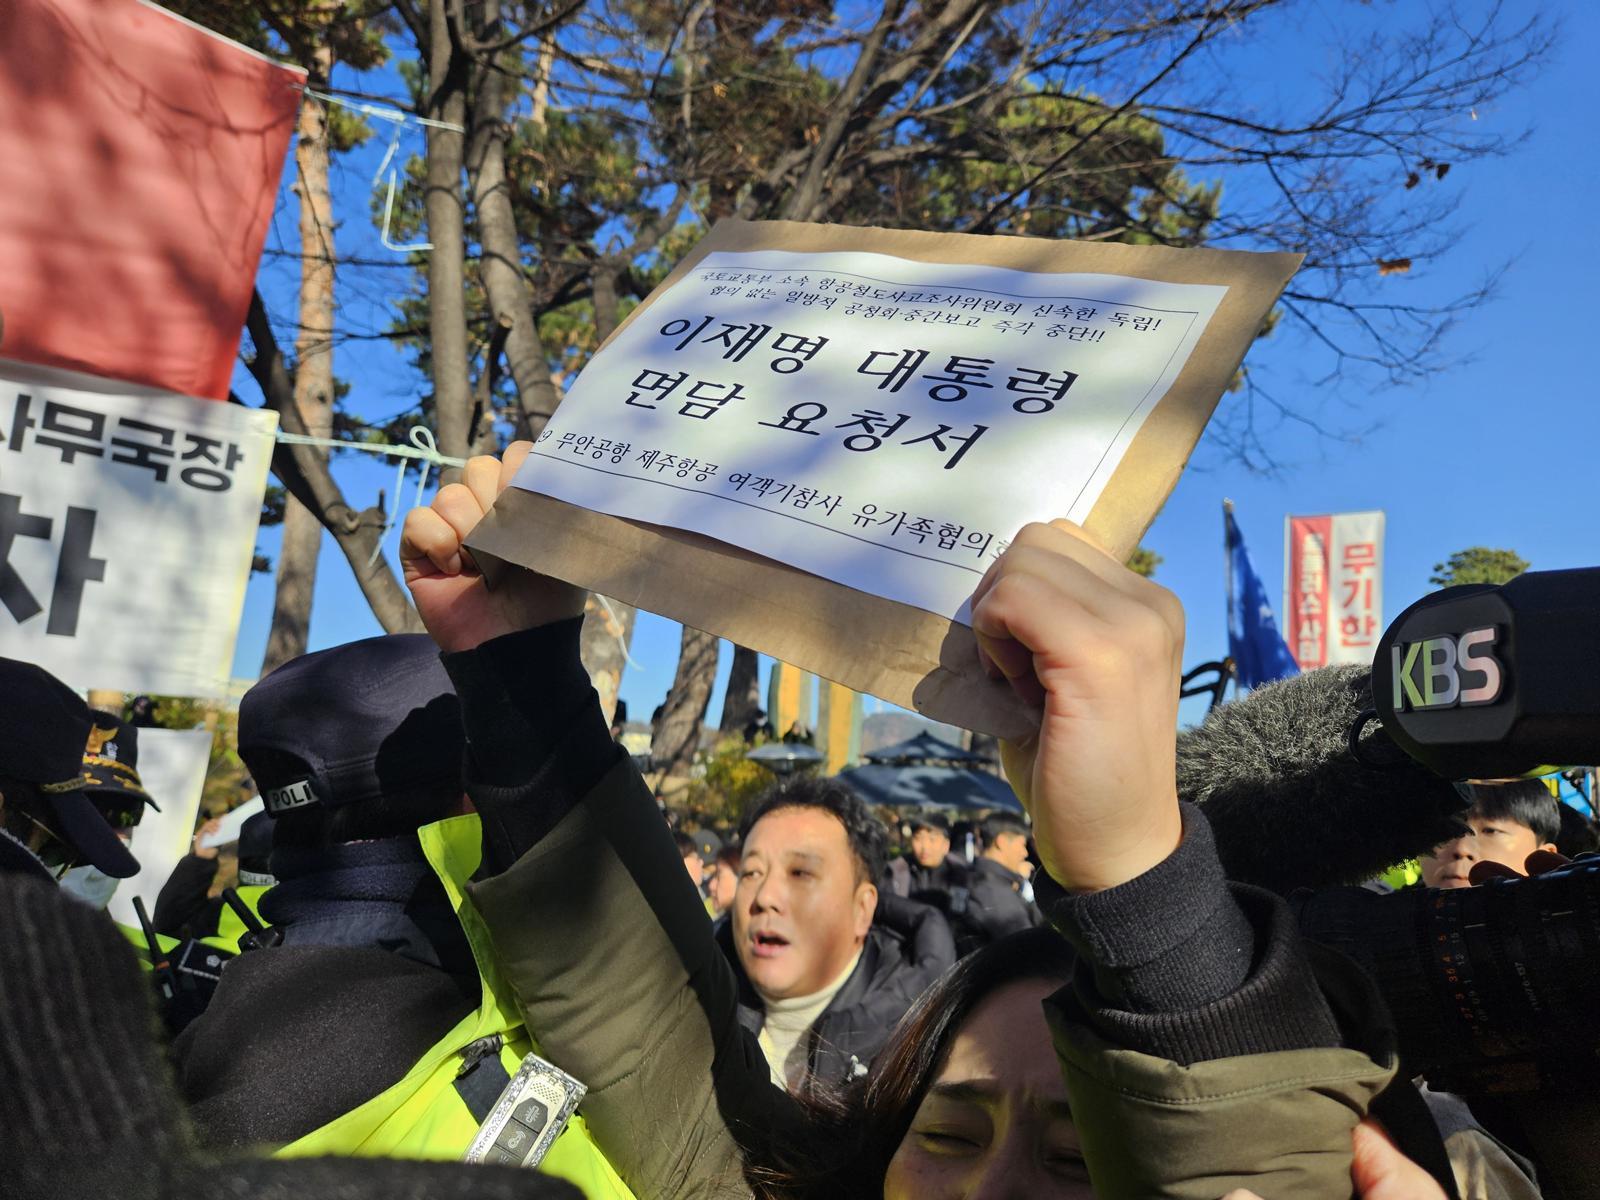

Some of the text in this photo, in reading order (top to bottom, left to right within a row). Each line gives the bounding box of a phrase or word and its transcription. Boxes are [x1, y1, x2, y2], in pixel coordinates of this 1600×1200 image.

[745, 288, 777, 299] 없는
[785, 290, 838, 310] 일방적
[992, 320, 1036, 336] 즉각
[1045, 324, 1106, 343] 중단!!
[776, 275, 809, 287] 소속
[819, 278, 1023, 316] 항공철도사고조사위원회
[1031, 304, 1098, 322] 신속한
[1107, 311, 1162, 331] 독립!
[660, 315, 1079, 414] 이재명 대통령
[625, 368, 990, 470] 면담 요청서
[556, 432, 631, 464] 무안공항
[635, 449, 719, 482] 제주항공
[728, 471, 843, 516] 여객기참사
[1341, 543, 1376, 647] 무기한
[1391, 627, 1500, 709] KBS
